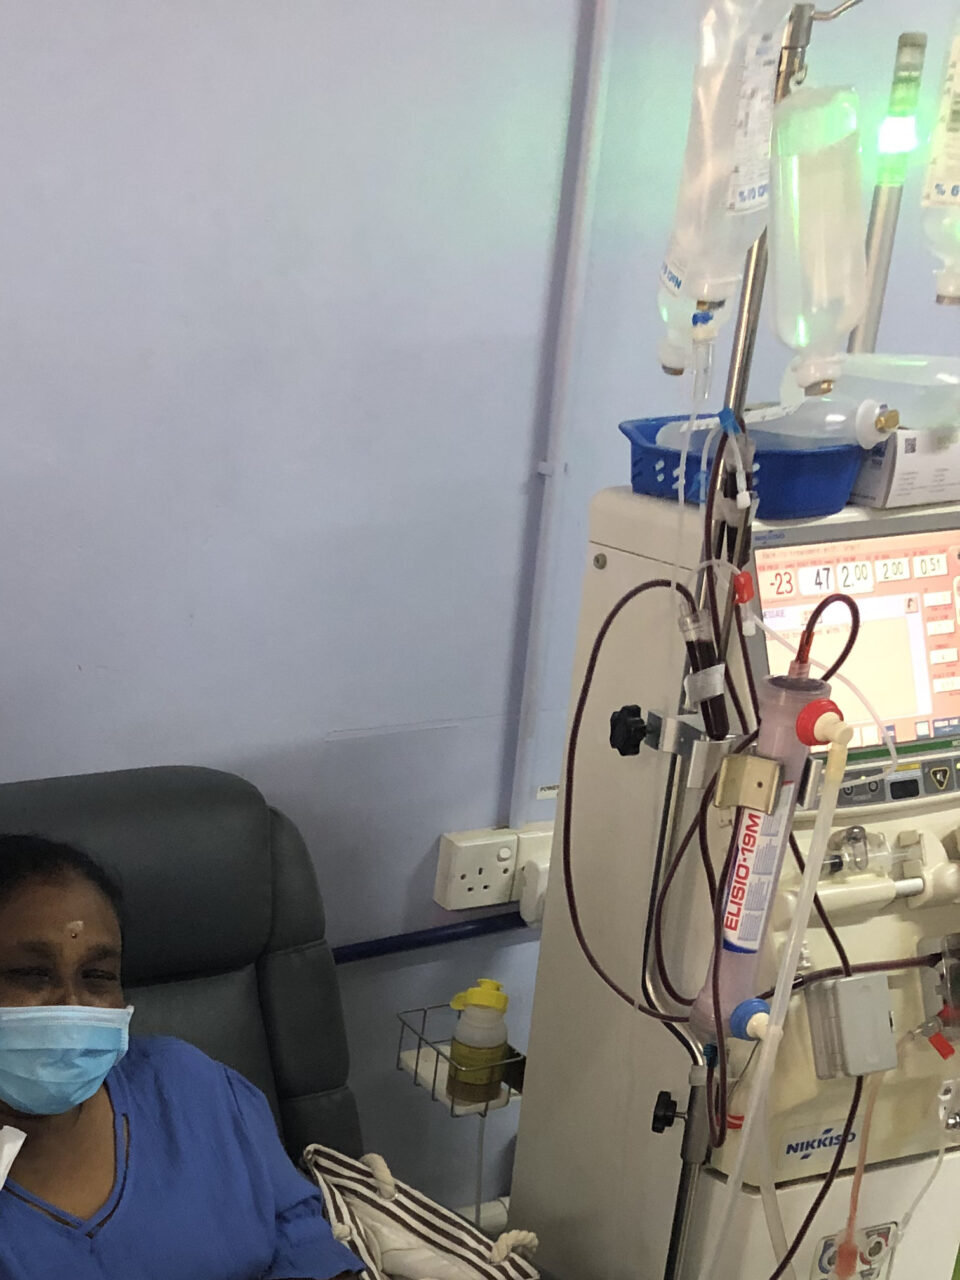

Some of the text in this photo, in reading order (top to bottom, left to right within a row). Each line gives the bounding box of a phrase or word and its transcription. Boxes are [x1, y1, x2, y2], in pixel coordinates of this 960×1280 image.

[770, 571, 793, 595] -23
[815, 567, 831, 590] 47
[786, 1132, 856, 1155] NIKKISO
